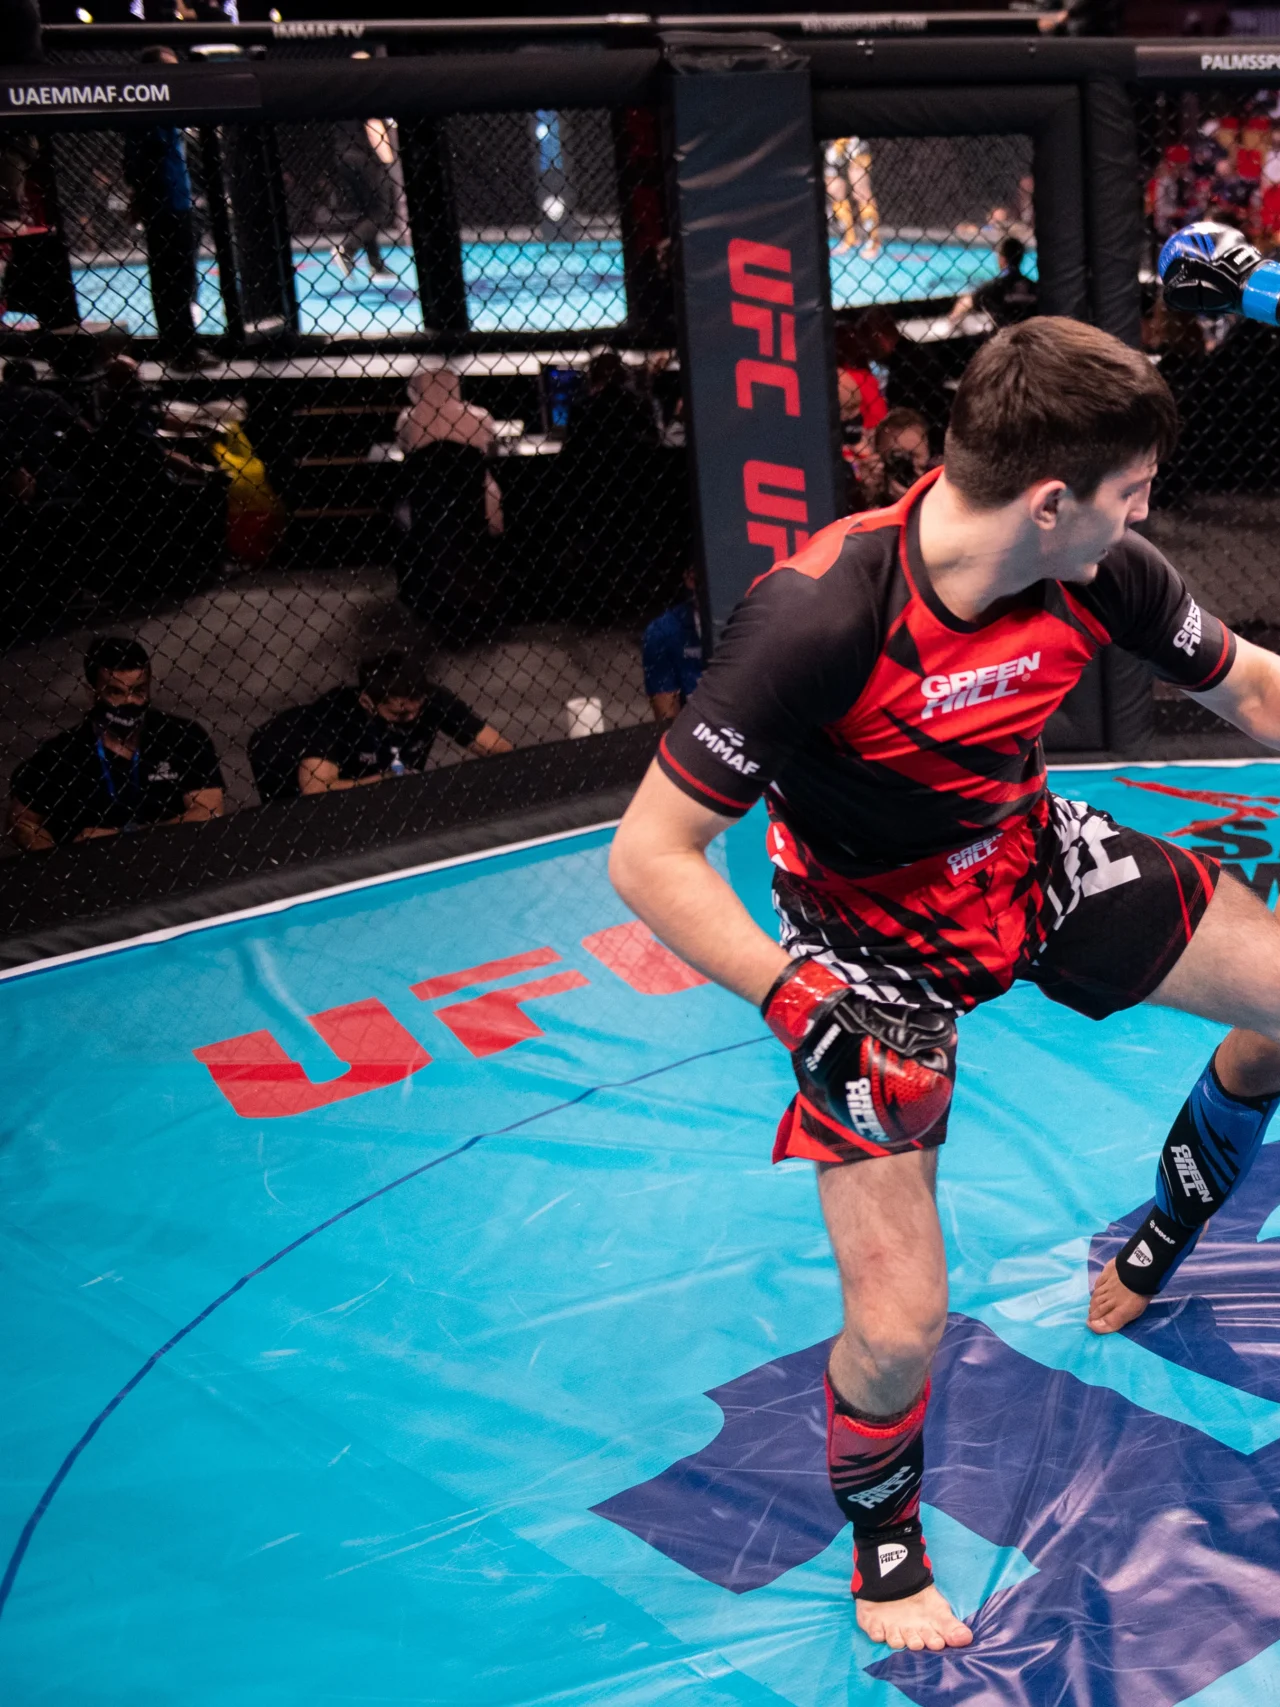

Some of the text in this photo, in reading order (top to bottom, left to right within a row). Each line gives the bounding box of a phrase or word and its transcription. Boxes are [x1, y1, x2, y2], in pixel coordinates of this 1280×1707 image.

[9, 84, 171, 106] UAEMMAF.COM
[727, 237, 801, 418] UFC
[920, 651, 1041, 699] GREEN
[920, 679, 1020, 720] HILL
[692, 722, 761, 776] IMMAF
[951, 845, 999, 876] HILL
[1170, 1146, 1194, 1198] HILL
[1180, 1144, 1214, 1203] GREEN
[879, 1548, 906, 1559] GREEN
[880, 1554, 904, 1565] HILL
